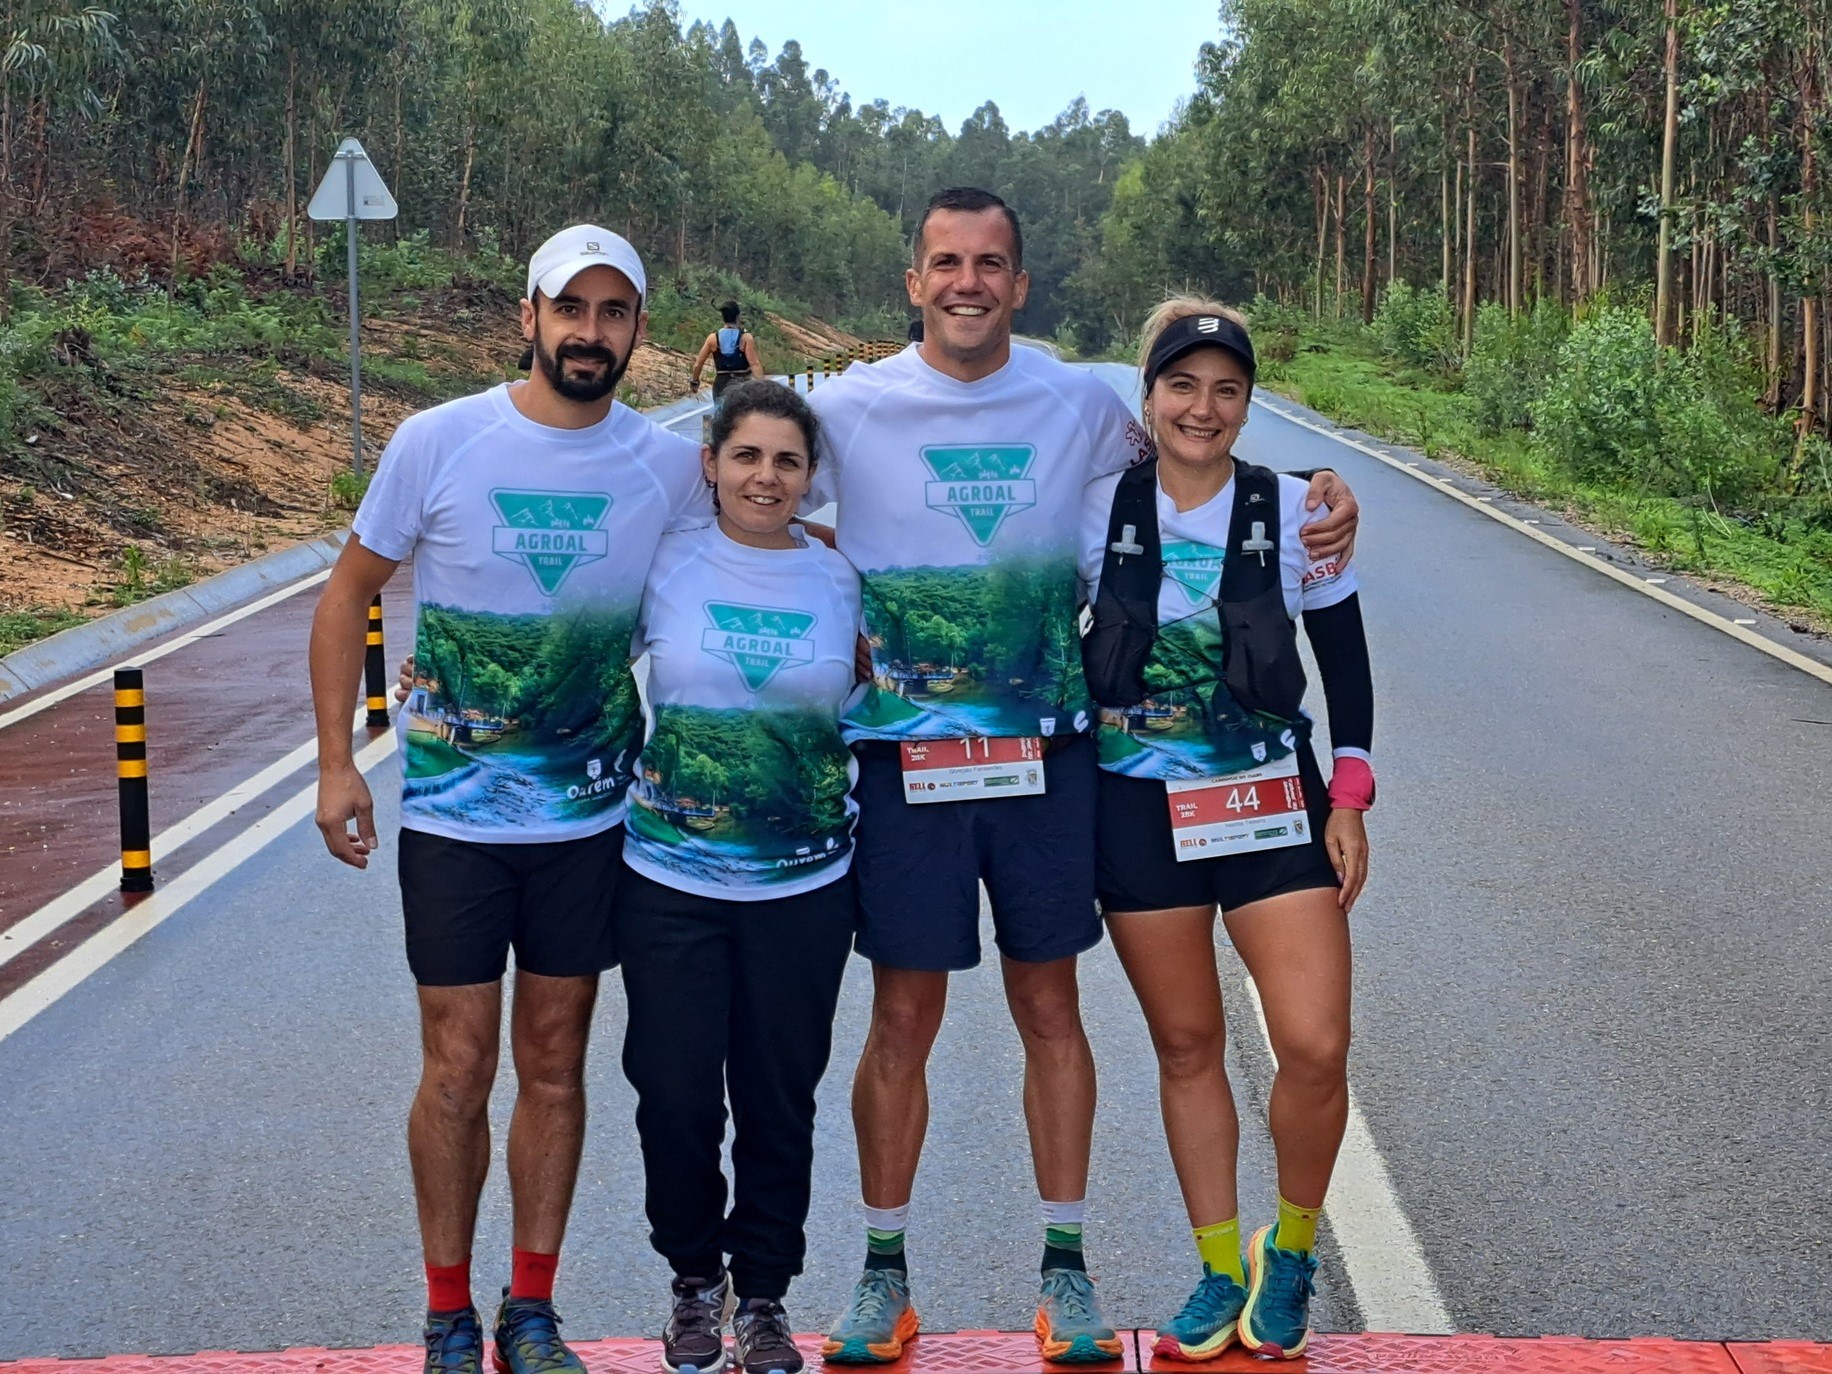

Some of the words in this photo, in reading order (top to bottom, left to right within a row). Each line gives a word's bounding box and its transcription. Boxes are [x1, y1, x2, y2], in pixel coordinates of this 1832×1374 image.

[947, 485, 1017, 502] AGROAL
[969, 508, 994, 517] TRAIL
[515, 532, 588, 552] AGROAL
[538, 556, 563, 566] TRAIL
[1184, 572, 1208, 581] TRAIL
[723, 635, 794, 656] AGROAL
[745, 656, 769, 667] TRAIL
[907, 746, 930, 754] TRAIL
[960, 737, 990, 760] 11
[566, 775, 615, 799] Ourém
[1225, 785, 1261, 813] 44
[1176, 803, 1198, 812] TRAIL
